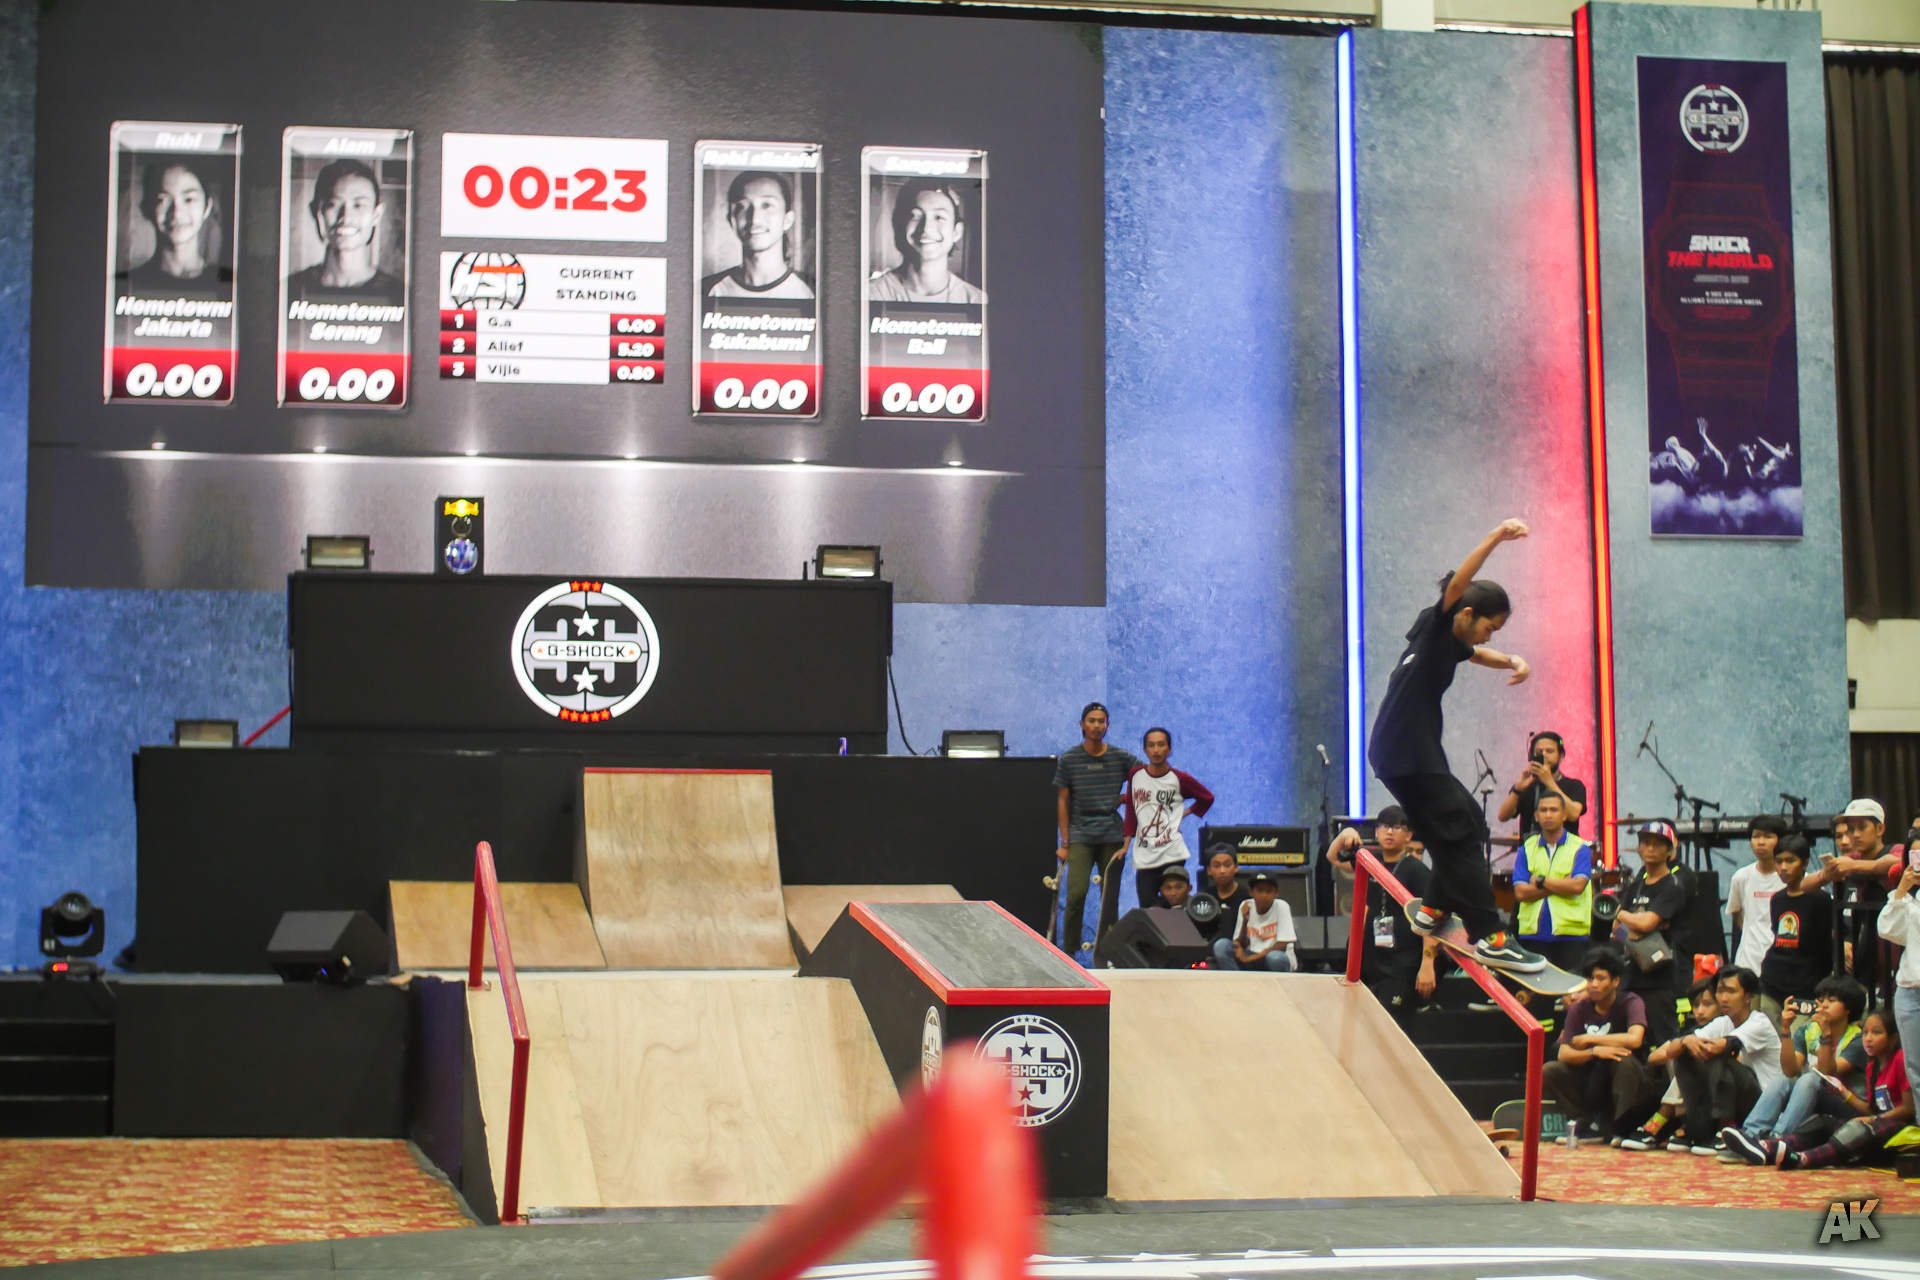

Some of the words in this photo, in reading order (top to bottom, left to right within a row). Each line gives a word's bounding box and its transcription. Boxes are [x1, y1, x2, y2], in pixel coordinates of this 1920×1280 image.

[463, 164, 647, 213] 00:23
[1688, 234, 1751, 254] SHOCK
[1667, 250, 1704, 269] THE
[1707, 252, 1774, 269] WORLD
[559, 267, 634, 280] CURRENT
[556, 288, 637, 301] STANDING
[134, 317, 212, 338] Jakarta
[454, 313, 465, 330] 1
[617, 317, 657, 333] 6.00
[703, 312, 816, 331] Hometown:
[870, 316, 982, 336] Hometown:
[309, 321, 382, 345] Serang
[709, 332, 810, 351] Sukabumi
[452, 337, 466, 353] 2
[906, 338, 948, 355] Bali
[452, 361, 465, 377] 3
[126, 362, 223, 398] 0.00
[299, 366, 396, 402] 0.00
[713, 377, 809, 410] 0.00
[881, 381, 975, 415] 0.00
[547, 644, 626, 658] G-SHOCK
[1237, 834, 1279, 848] Marshall
